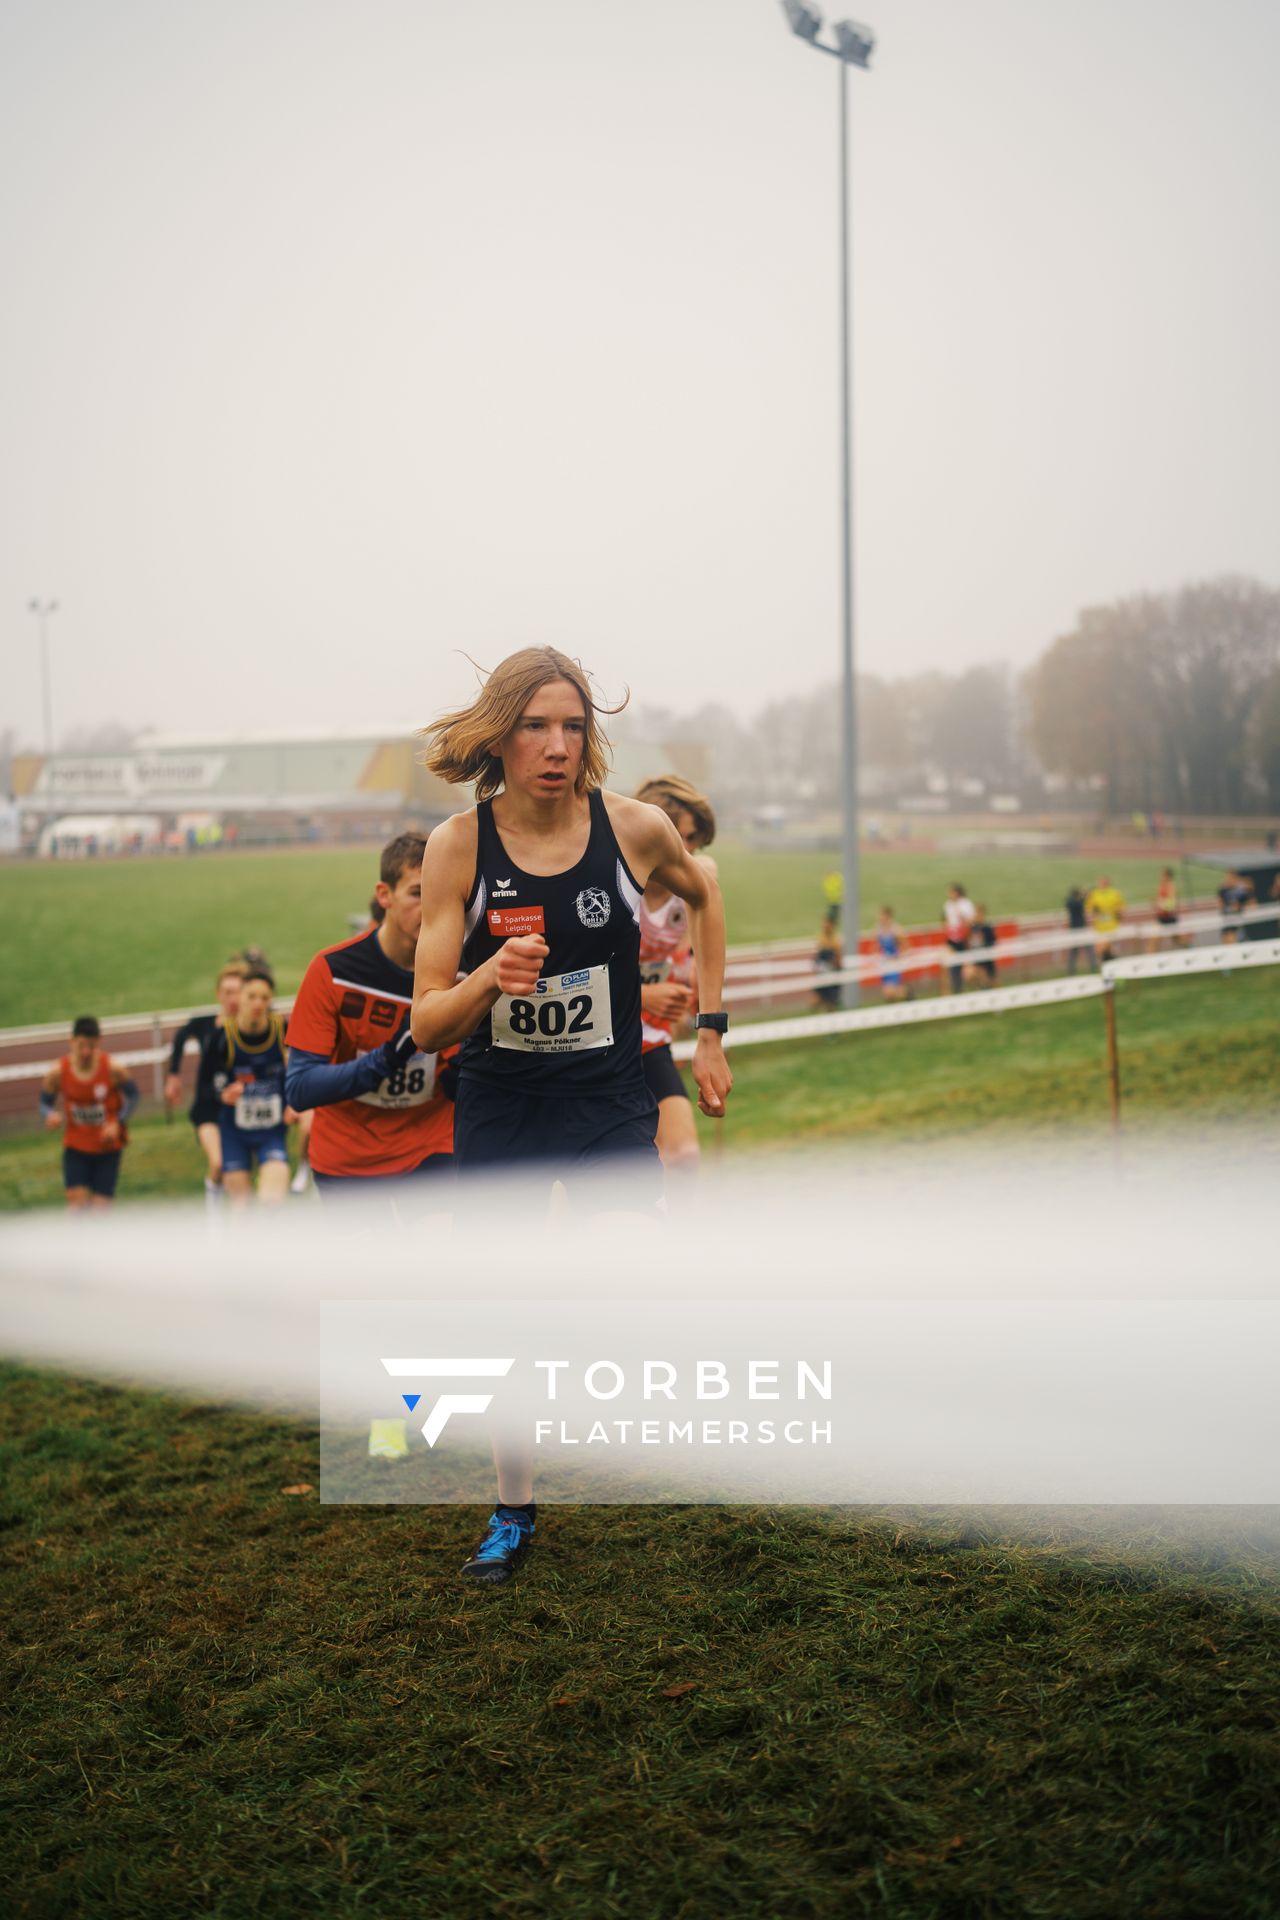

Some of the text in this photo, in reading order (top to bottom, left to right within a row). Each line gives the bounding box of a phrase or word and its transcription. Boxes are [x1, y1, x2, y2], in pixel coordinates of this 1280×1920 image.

[505, 915, 542, 924] Sparkasse
[509, 995, 594, 1037] 802
[524, 1037, 552, 1046] Magnus
